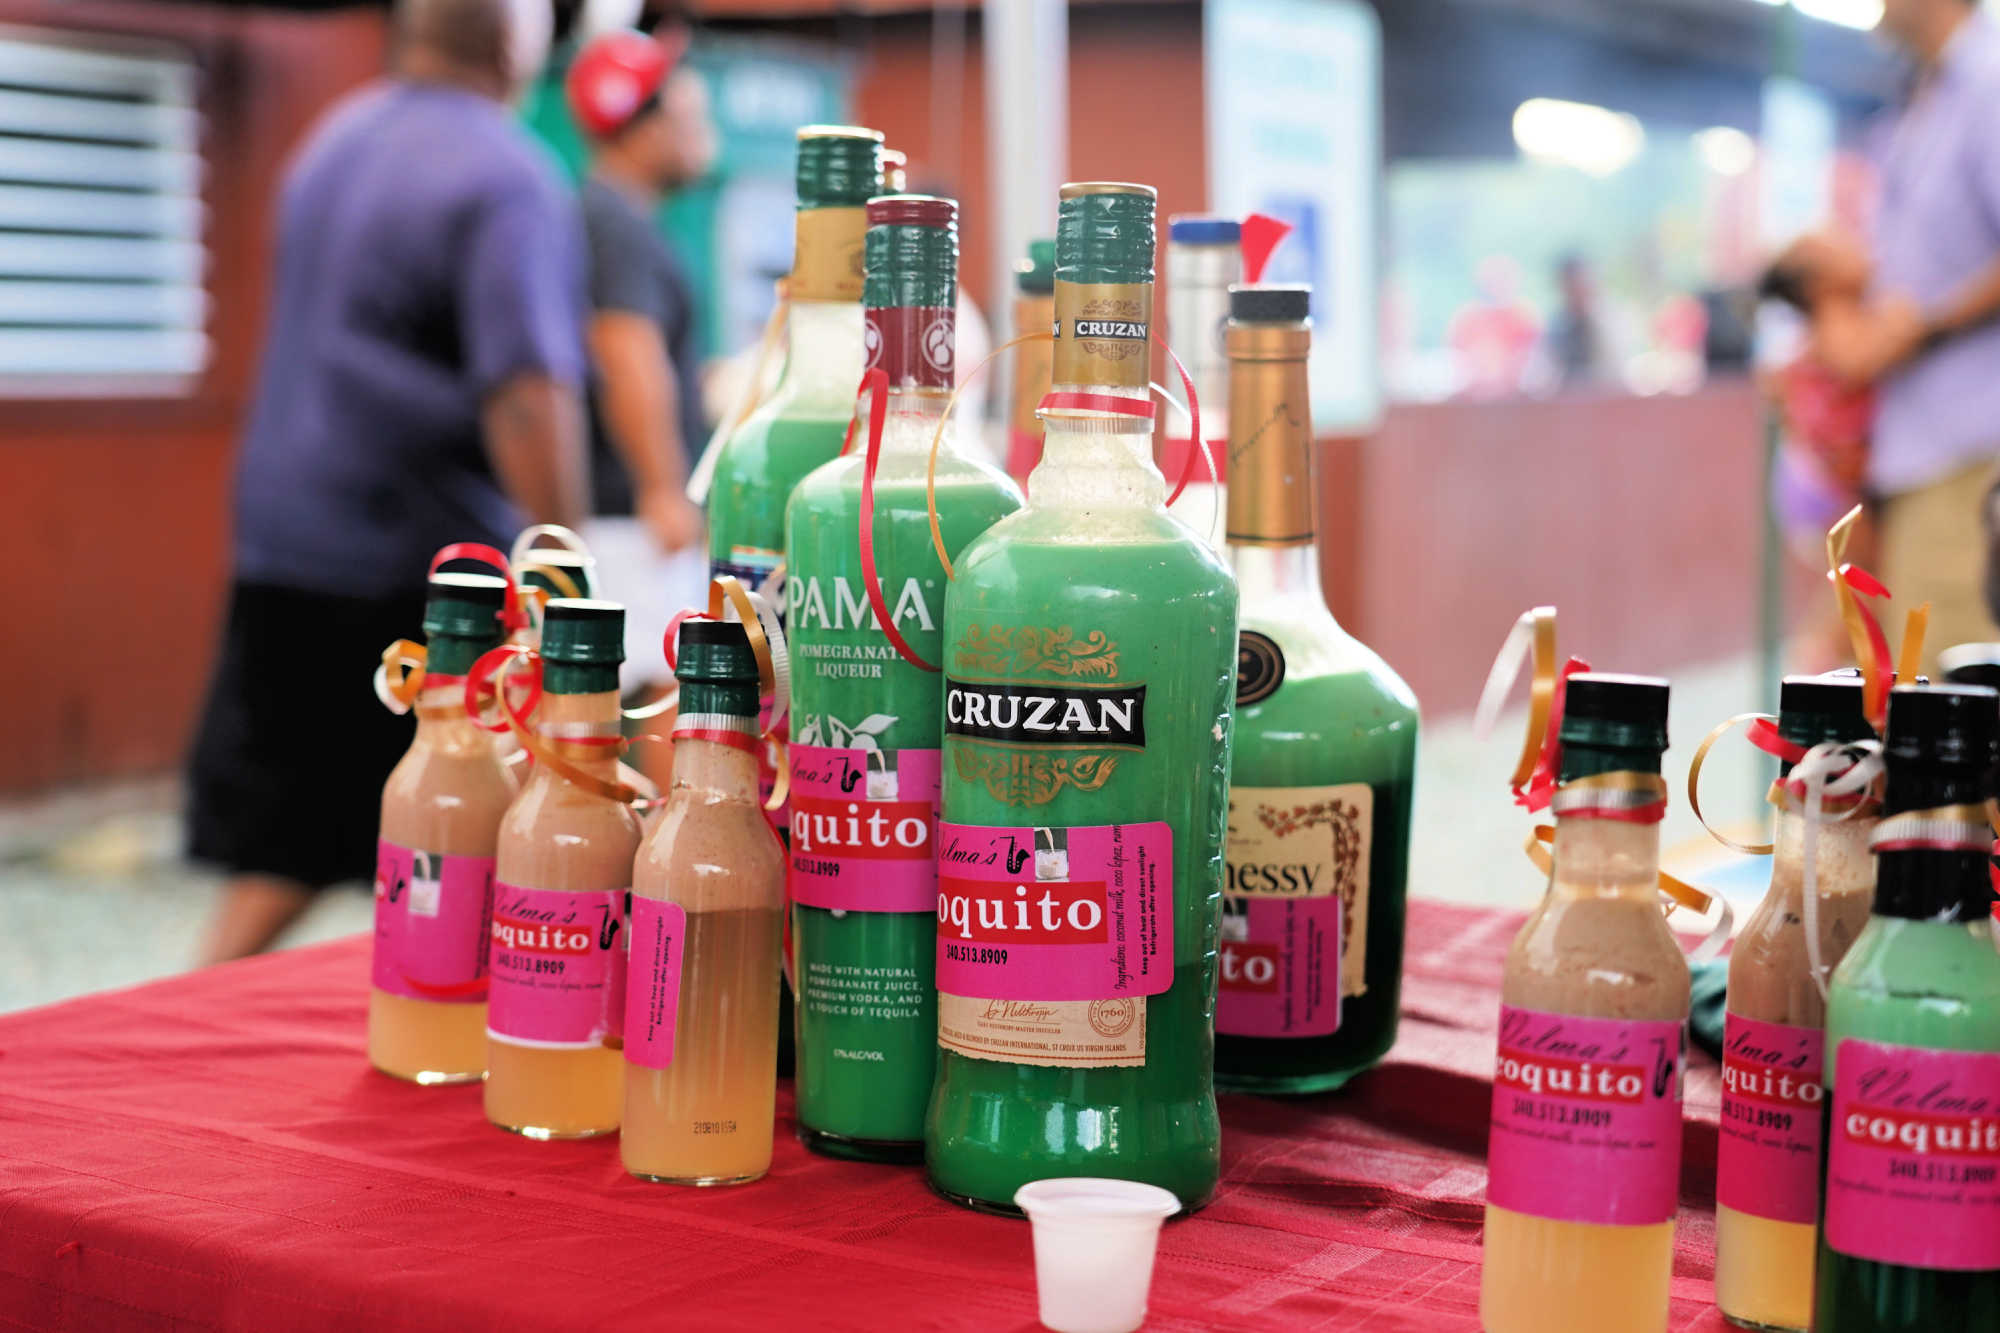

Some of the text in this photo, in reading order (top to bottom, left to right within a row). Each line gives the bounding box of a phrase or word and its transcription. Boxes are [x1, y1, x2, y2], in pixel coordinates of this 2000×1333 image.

[1076, 321, 1147, 338] CRUZAN
[789, 576, 935, 631] PAMA
[800, 643, 906, 660] POMEGRANAT
[815, 663, 882, 679] LIQUEUR
[947, 688, 1135, 732] CRUZAN
[1137, 846, 1146, 876] sunlight
[1138, 878, 1146, 898] direct
[1139, 915, 1147, 932] heat
[946, 944, 1008, 965] 340.513.8909
[810, 963, 916, 978] MADE WITH NATURAL
[808, 976, 880, 991] POMEGRANATE
[808, 988, 923, 1005] PREMIUM VODKA, AND
[816, 1003, 848, 1014] TOUCH
[851, 1007, 864, 1016] OF
[869, 1007, 920, 1019] TEQUILA
[1099, 1008, 1125, 1020] 1760
[1846, 1113, 2000, 1154] coquit
